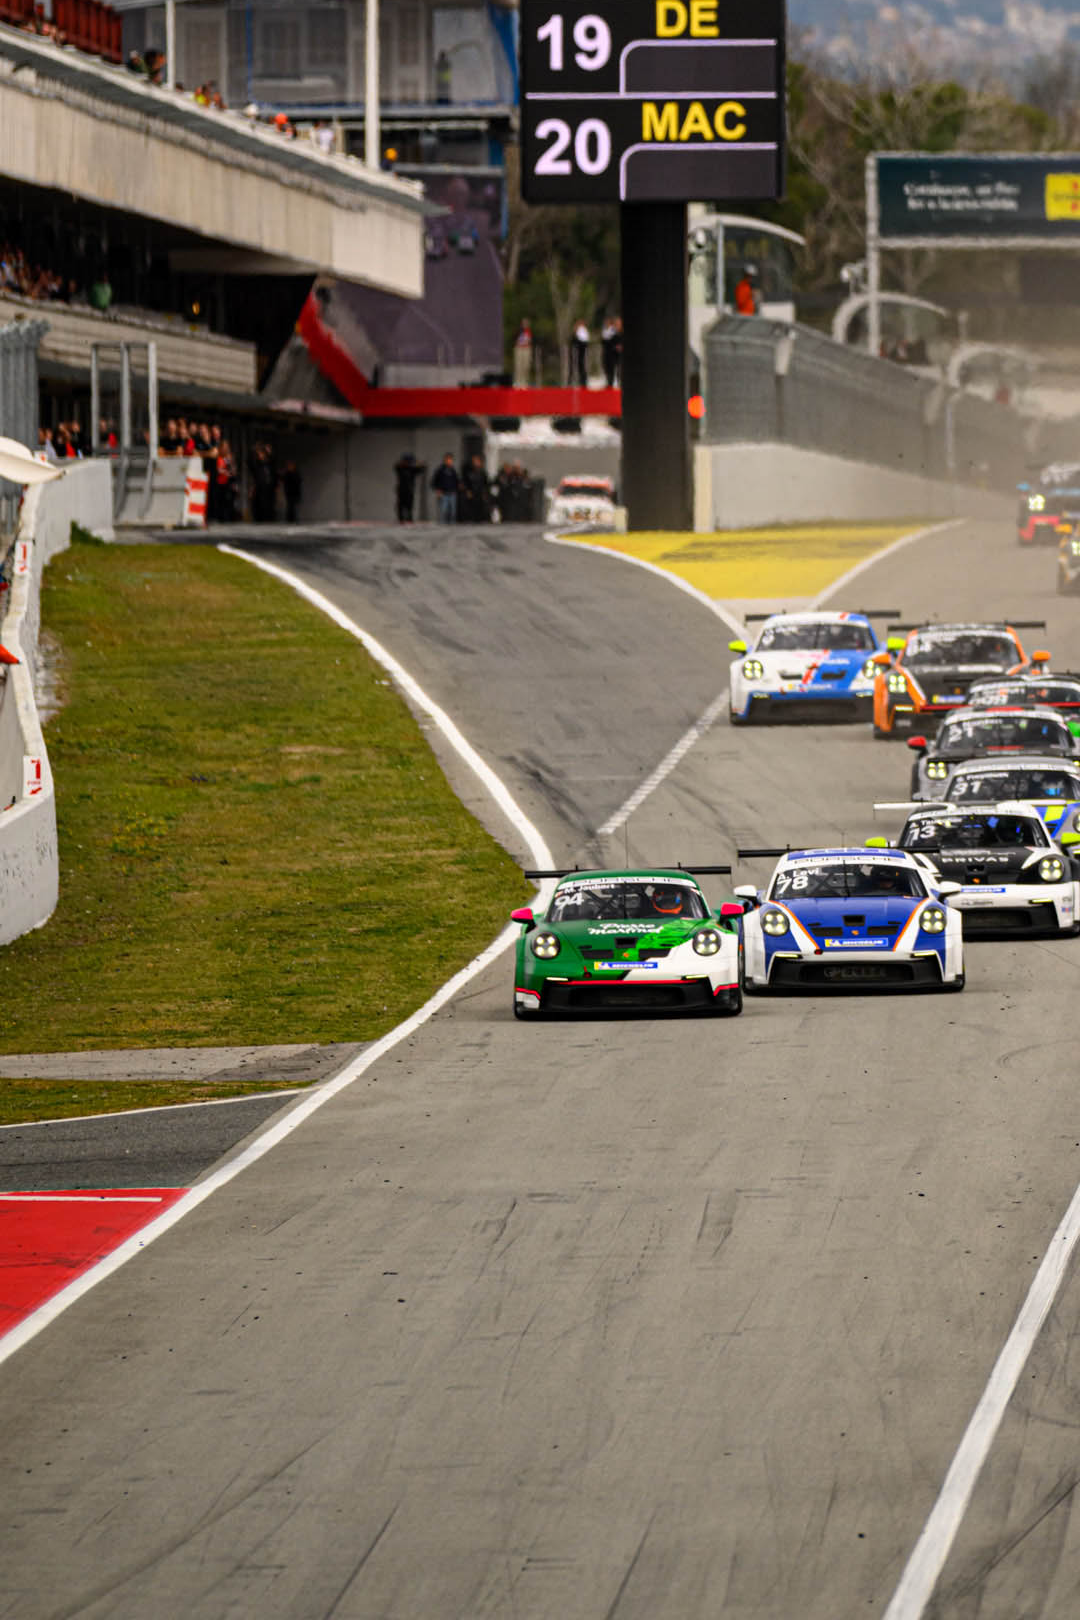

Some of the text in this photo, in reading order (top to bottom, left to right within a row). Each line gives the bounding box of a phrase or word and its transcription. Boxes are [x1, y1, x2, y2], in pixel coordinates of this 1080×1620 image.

[537, 15, 611, 71] 19
[534, 101, 747, 175] 20 MAC
[909, 825, 936, 841] 13
[776, 874, 809, 894] 78
[554, 892, 584, 909] 94
